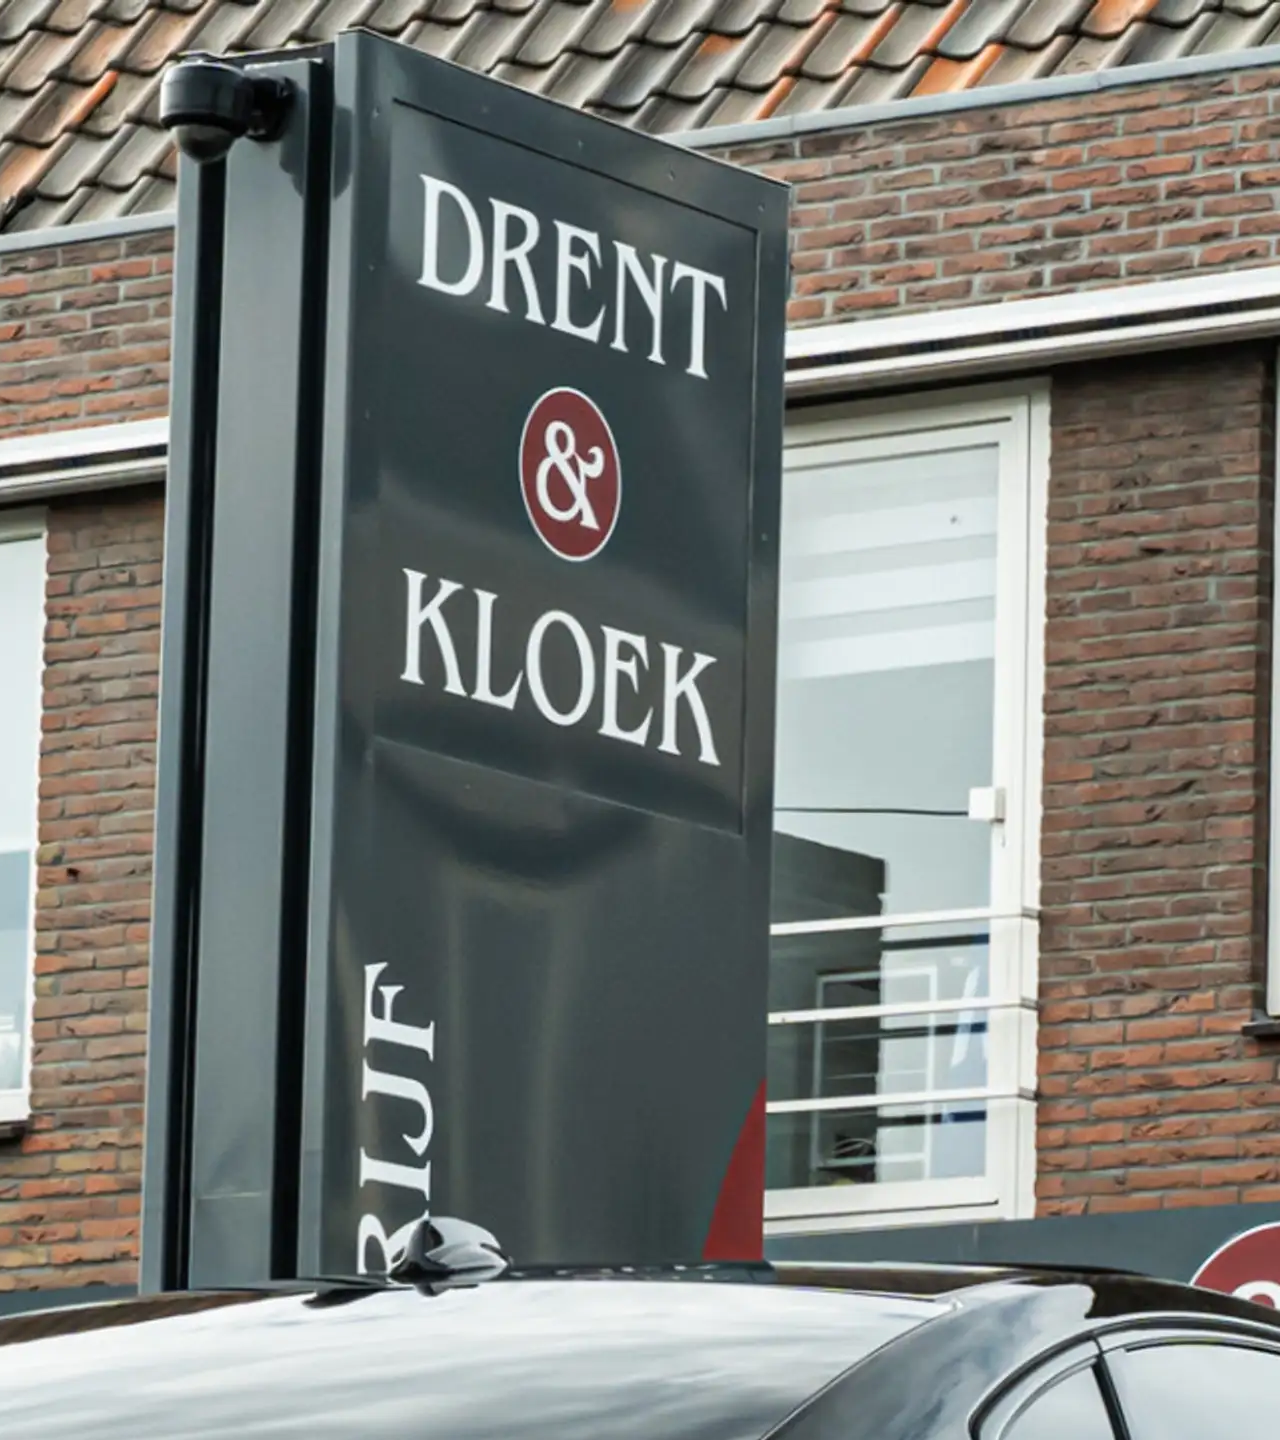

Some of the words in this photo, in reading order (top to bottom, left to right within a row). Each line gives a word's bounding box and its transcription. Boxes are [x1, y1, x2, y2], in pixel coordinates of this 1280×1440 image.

[417, 174, 728, 380] DRENT
[535, 420, 605, 530] &
[399, 567, 720, 766] KLOEK
